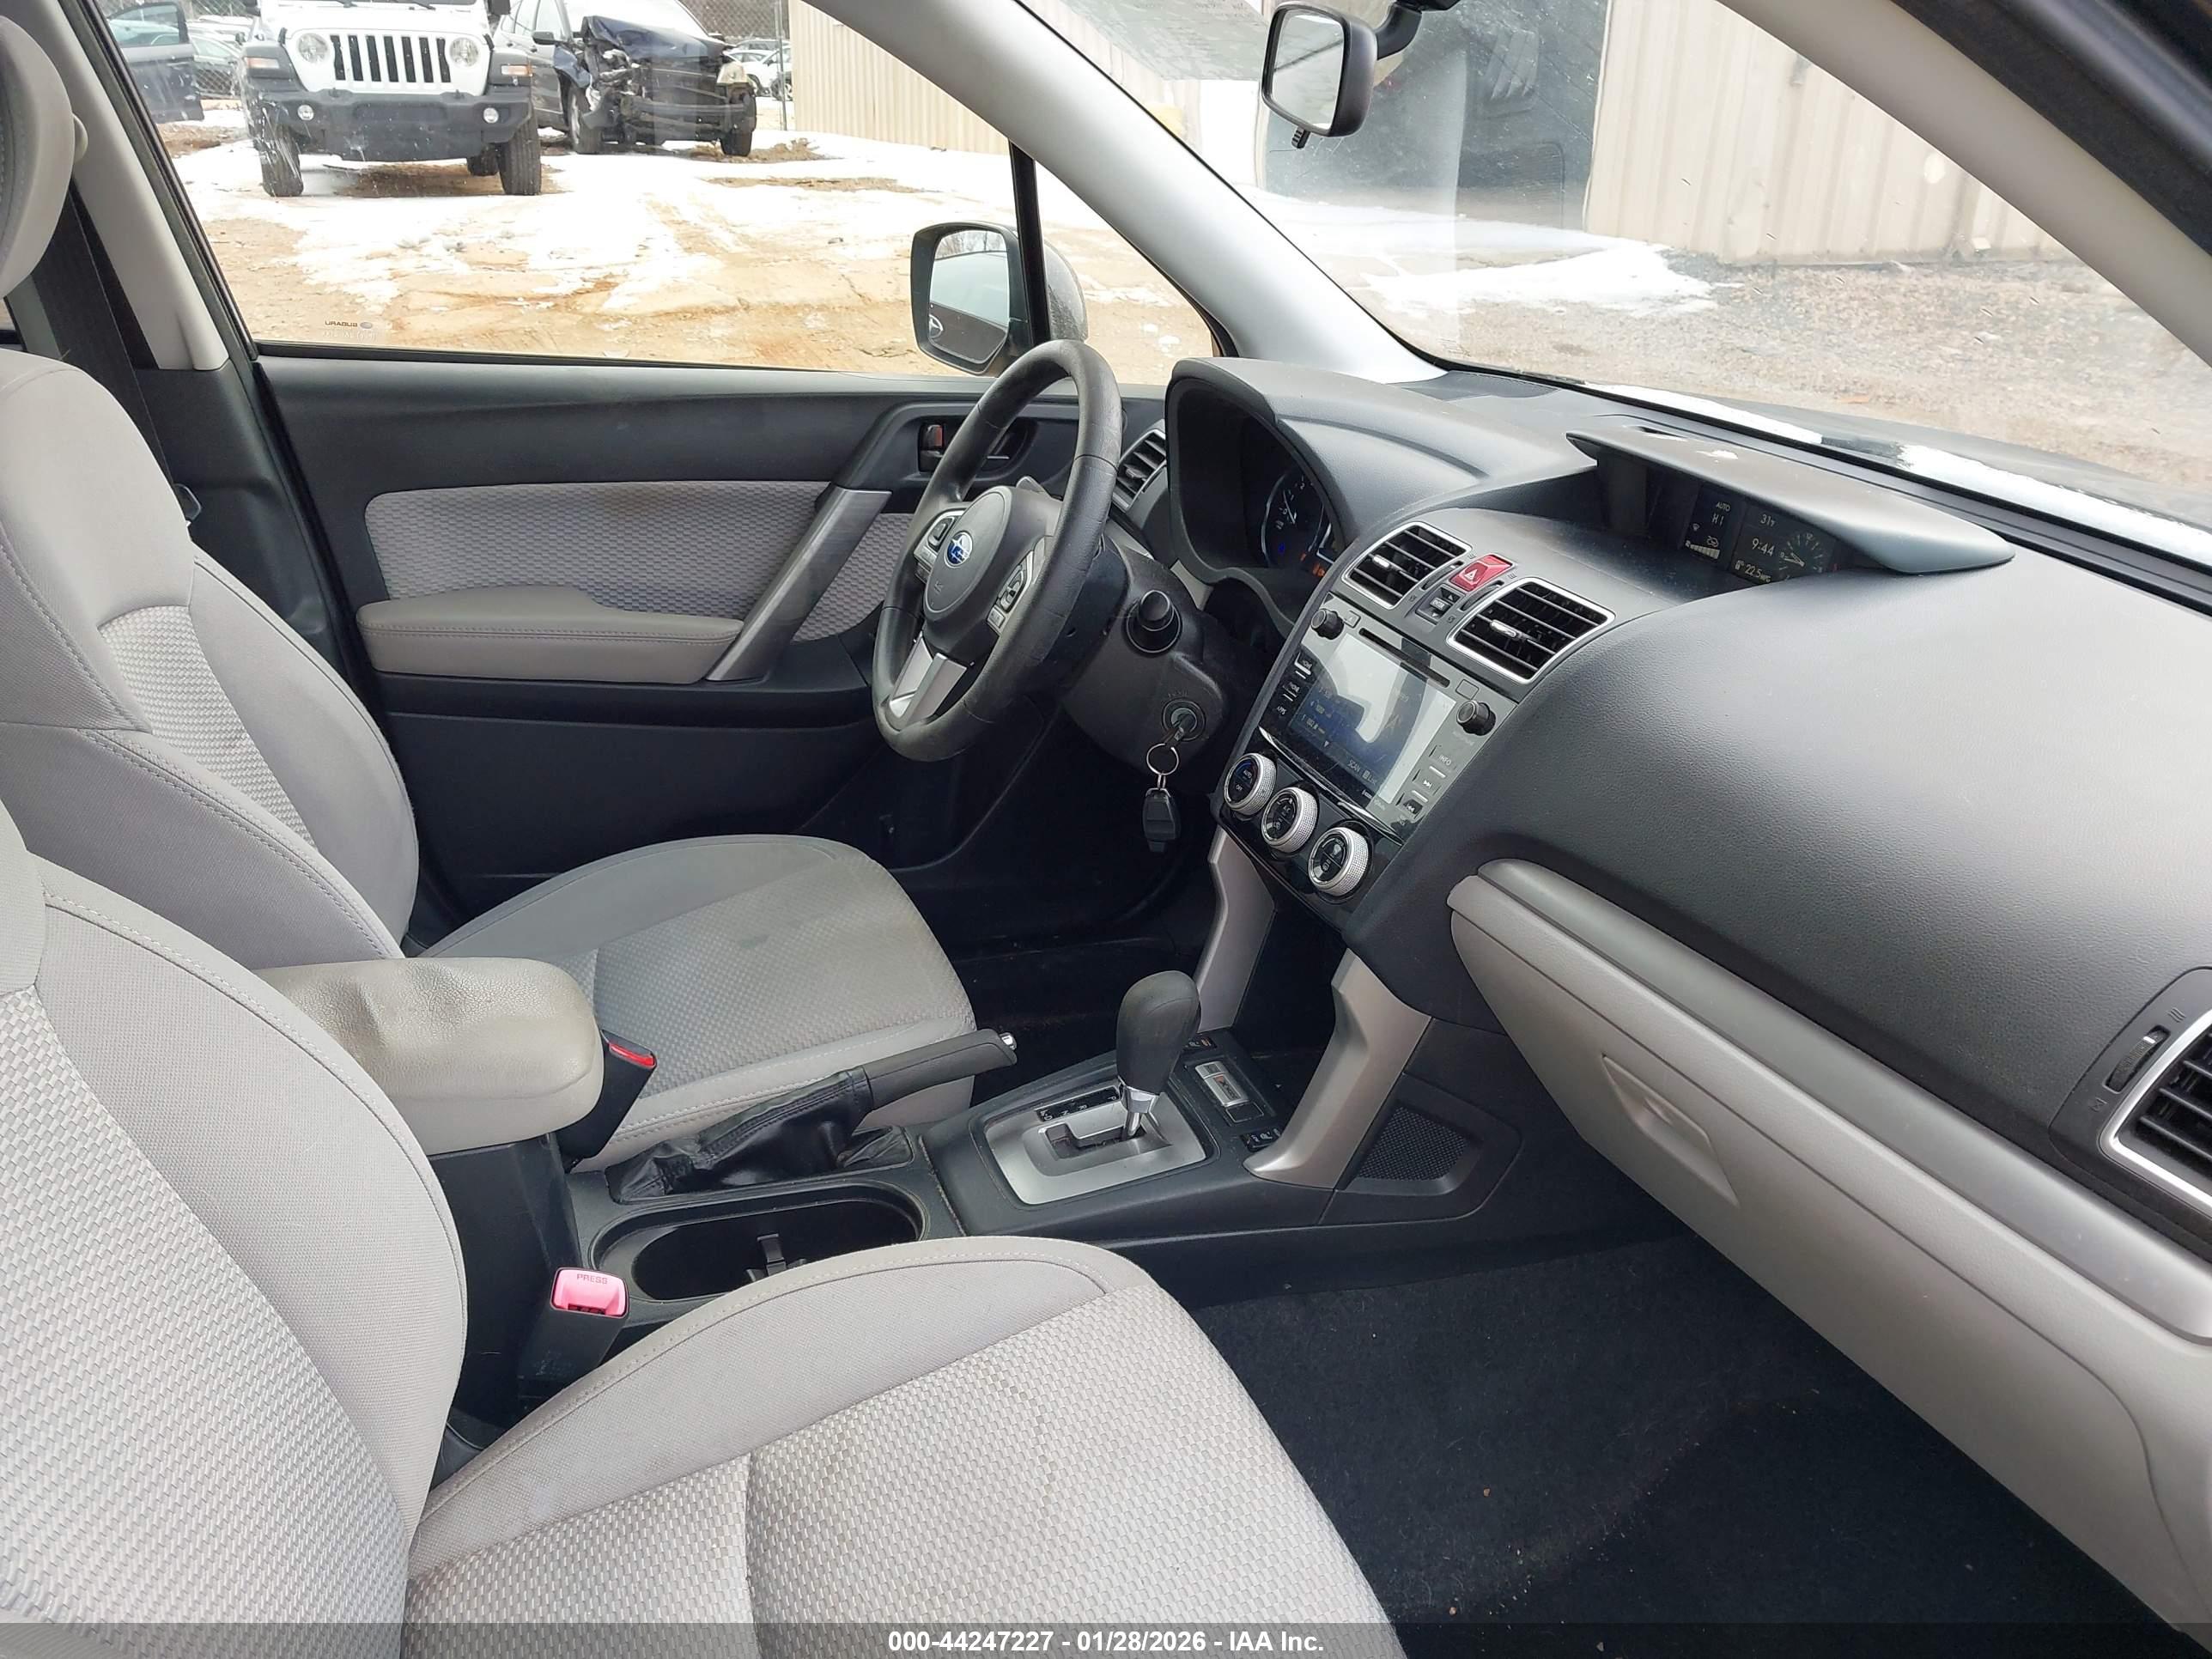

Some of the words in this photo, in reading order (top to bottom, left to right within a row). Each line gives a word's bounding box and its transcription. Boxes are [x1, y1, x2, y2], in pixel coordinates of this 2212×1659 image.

[1716, 501, 1731, 512] AUTO
[1752, 538, 1775, 557] 9:44
[1347, 758, 1361, 773] SCAN
[1438, 755, 1452, 767] INFO
[576, 1273, 609, 1285] PRESS
